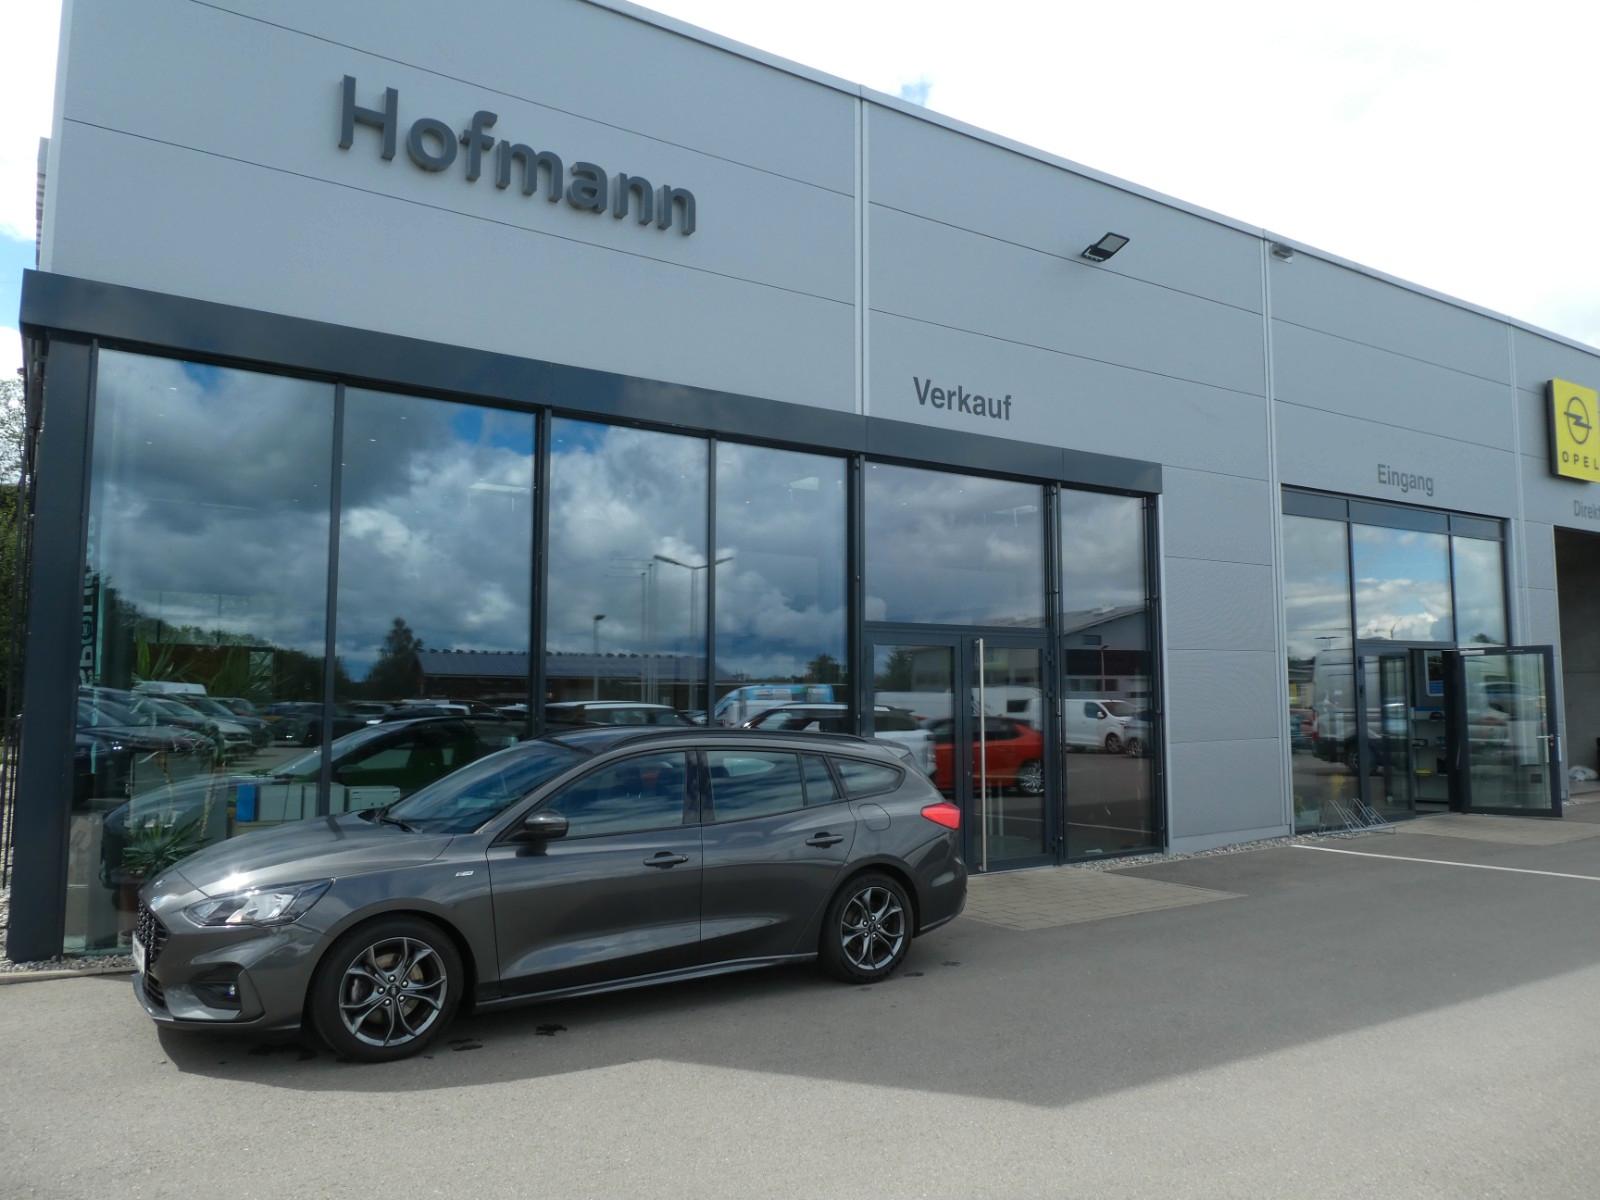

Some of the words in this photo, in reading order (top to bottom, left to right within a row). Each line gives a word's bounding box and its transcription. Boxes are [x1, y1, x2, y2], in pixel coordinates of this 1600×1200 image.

[338, 74, 697, 236] Hofmann
[913, 376, 1012, 421] Verkauf
[1377, 463, 1434, 497] Eingang
[1562, 451, 1600, 471] OPEL
